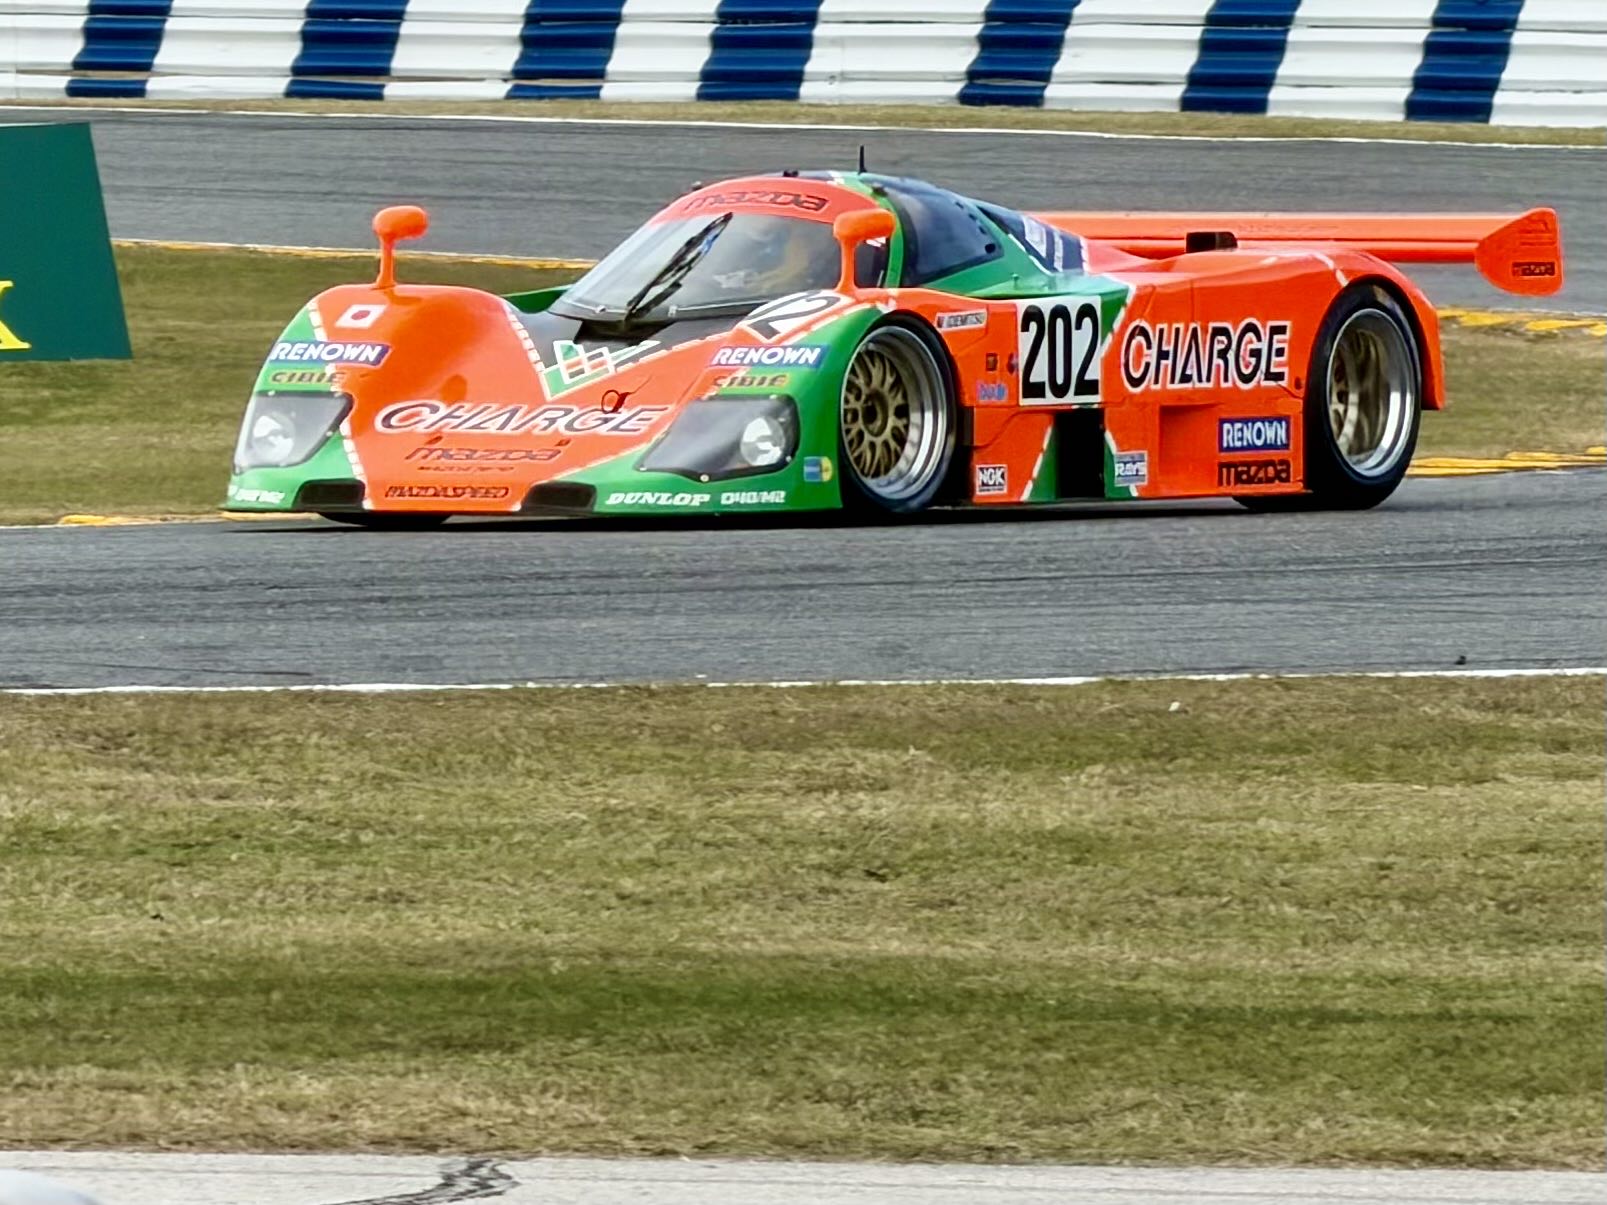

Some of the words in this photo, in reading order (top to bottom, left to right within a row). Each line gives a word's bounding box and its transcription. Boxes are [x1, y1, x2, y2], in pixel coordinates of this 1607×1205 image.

[269, 342, 381, 362] RENOWN
[711, 346, 821, 366] RENOWN
[1020, 302, 1100, 399] 202
[1122, 318, 1291, 393] CHARGE
[374, 400, 671, 436] CHARGE
[1222, 421, 1288, 449] RENOWN
[978, 467, 1006, 486] NGK
[1218, 459, 1291, 486] mazda
[605, 490, 711, 507] DUNLOP
